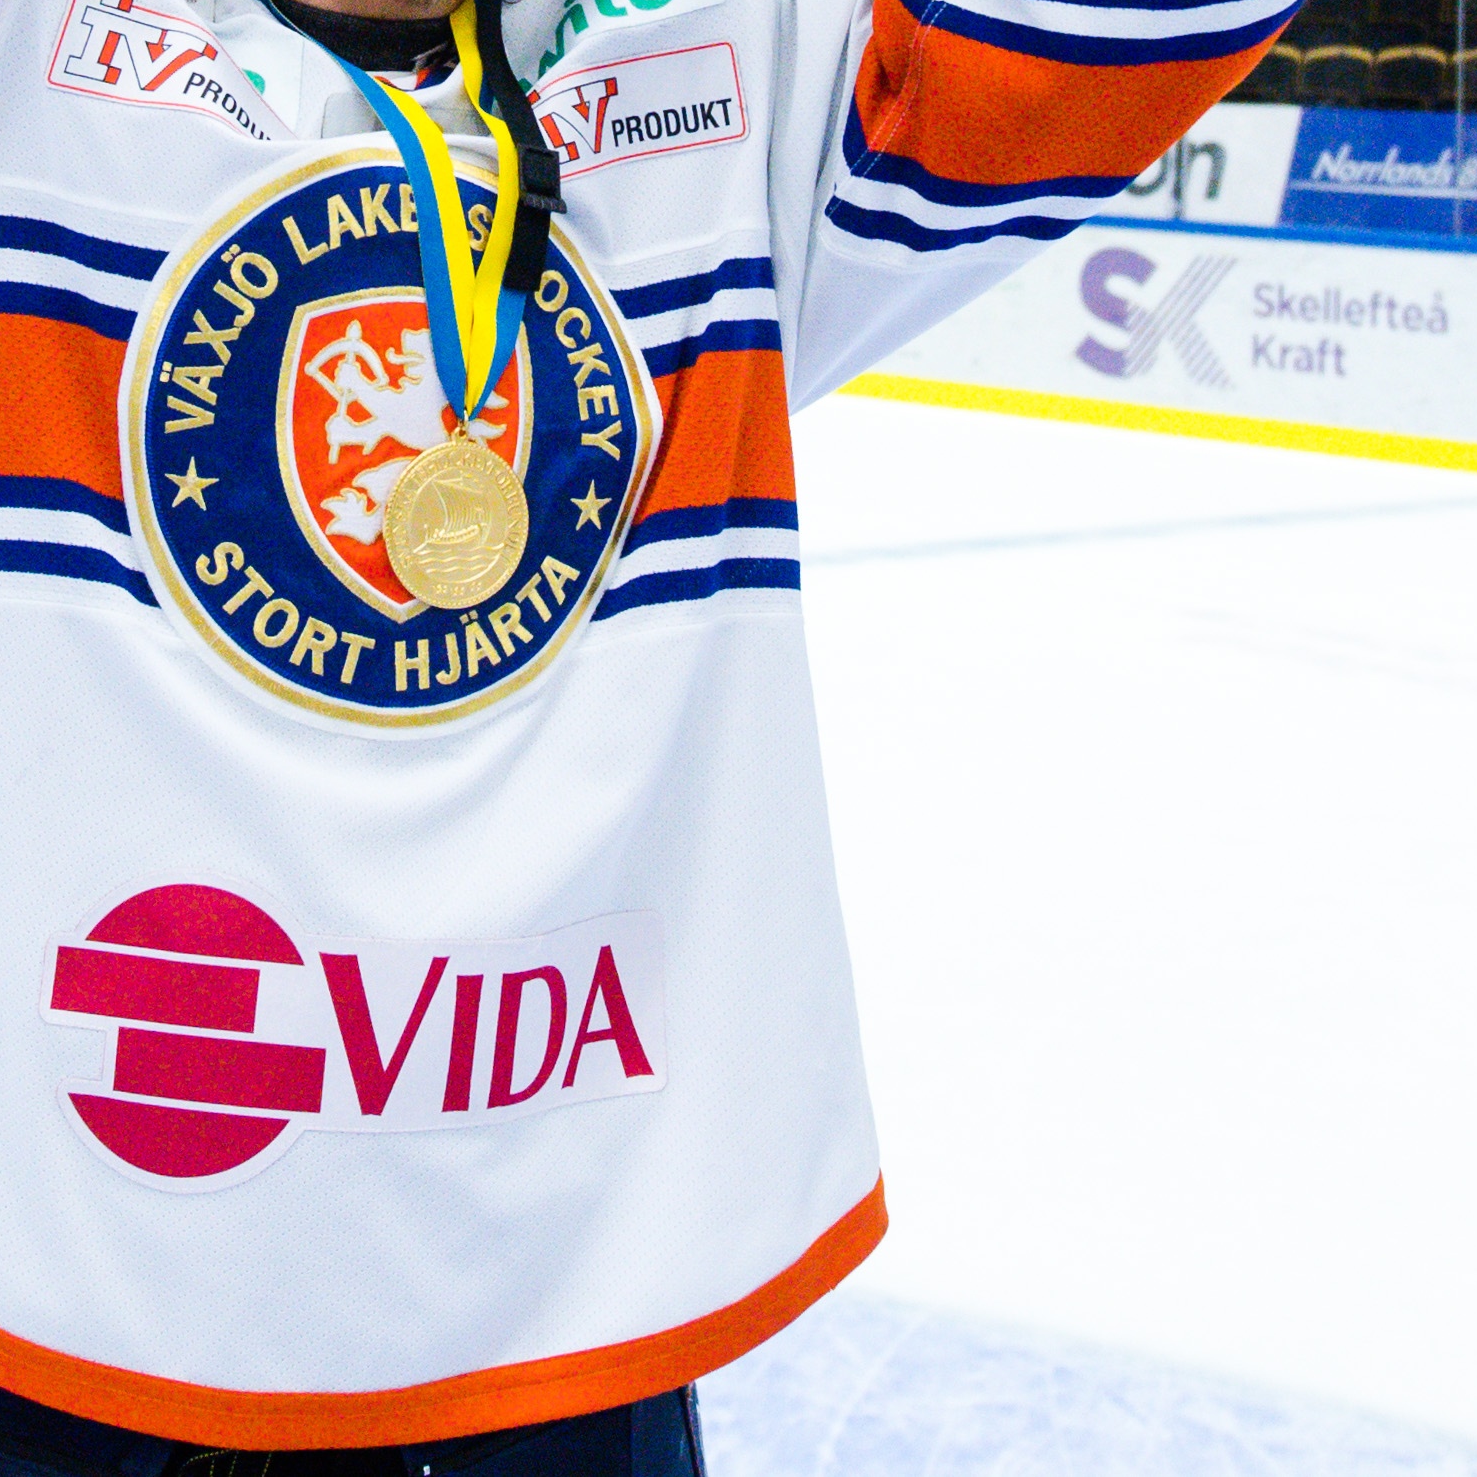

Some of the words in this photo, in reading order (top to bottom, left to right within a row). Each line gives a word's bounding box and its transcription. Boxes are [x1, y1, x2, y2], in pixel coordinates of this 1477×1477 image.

[182, 71, 273, 142] PRODU
[611, 97, 733, 148] PRODUKT
[1310, 143, 1454, 185] Norrlands
[159, 243, 279, 434] VÄXJÖ
[282, 182, 495, 266] LAKES
[534, 269, 623, 461] OCKEY
[1253, 282, 1449, 335] Skellefteå
[1252, 333, 1347, 377] Kraft
[195, 540, 376, 685] STORT
[394, 552, 581, 693] HJÄRTA
[318, 943, 657, 1116] VIDA
